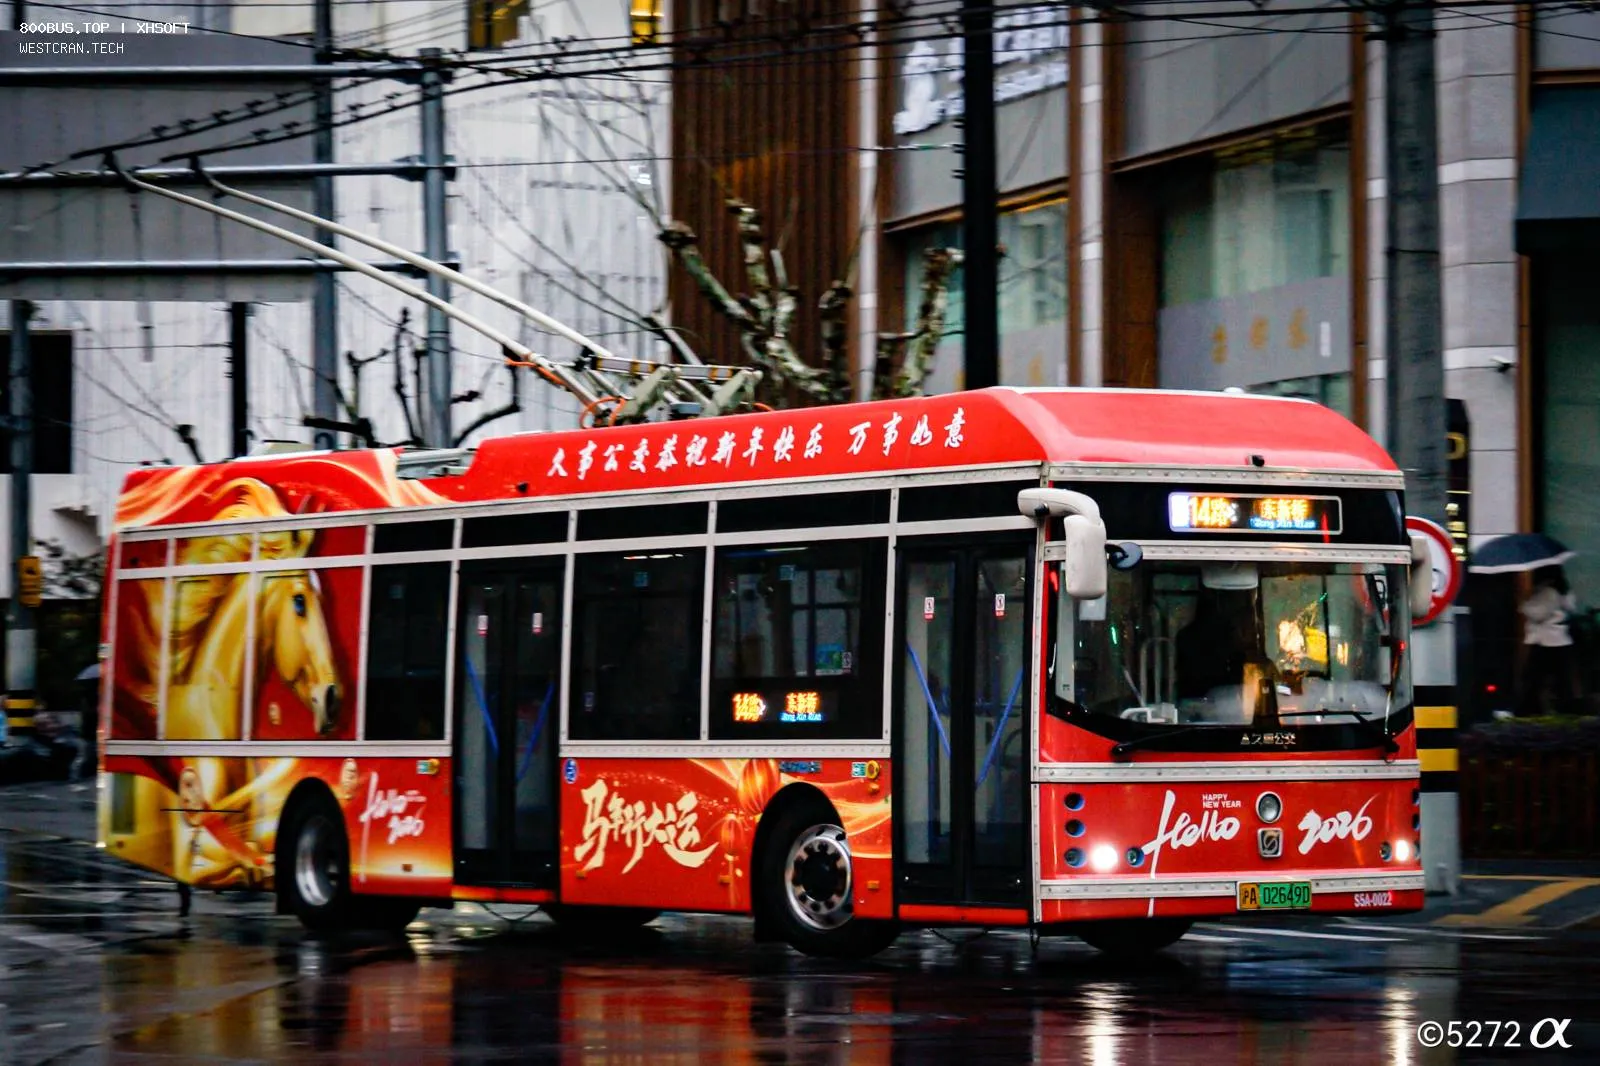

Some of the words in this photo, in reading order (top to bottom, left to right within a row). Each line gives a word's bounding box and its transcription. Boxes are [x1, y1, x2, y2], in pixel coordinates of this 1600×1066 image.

[547, 423, 823, 481] 久事公交恭祝新年快乐
[846, 406, 967, 456] 万事如意
[1202, 793, 1228, 802] HAPPY
[1202, 800, 1220, 809] NEW
[1221, 800, 1242, 809] YEAR
[1297, 793, 1380, 855] 2026
[1141, 789, 1241, 918] Hello
